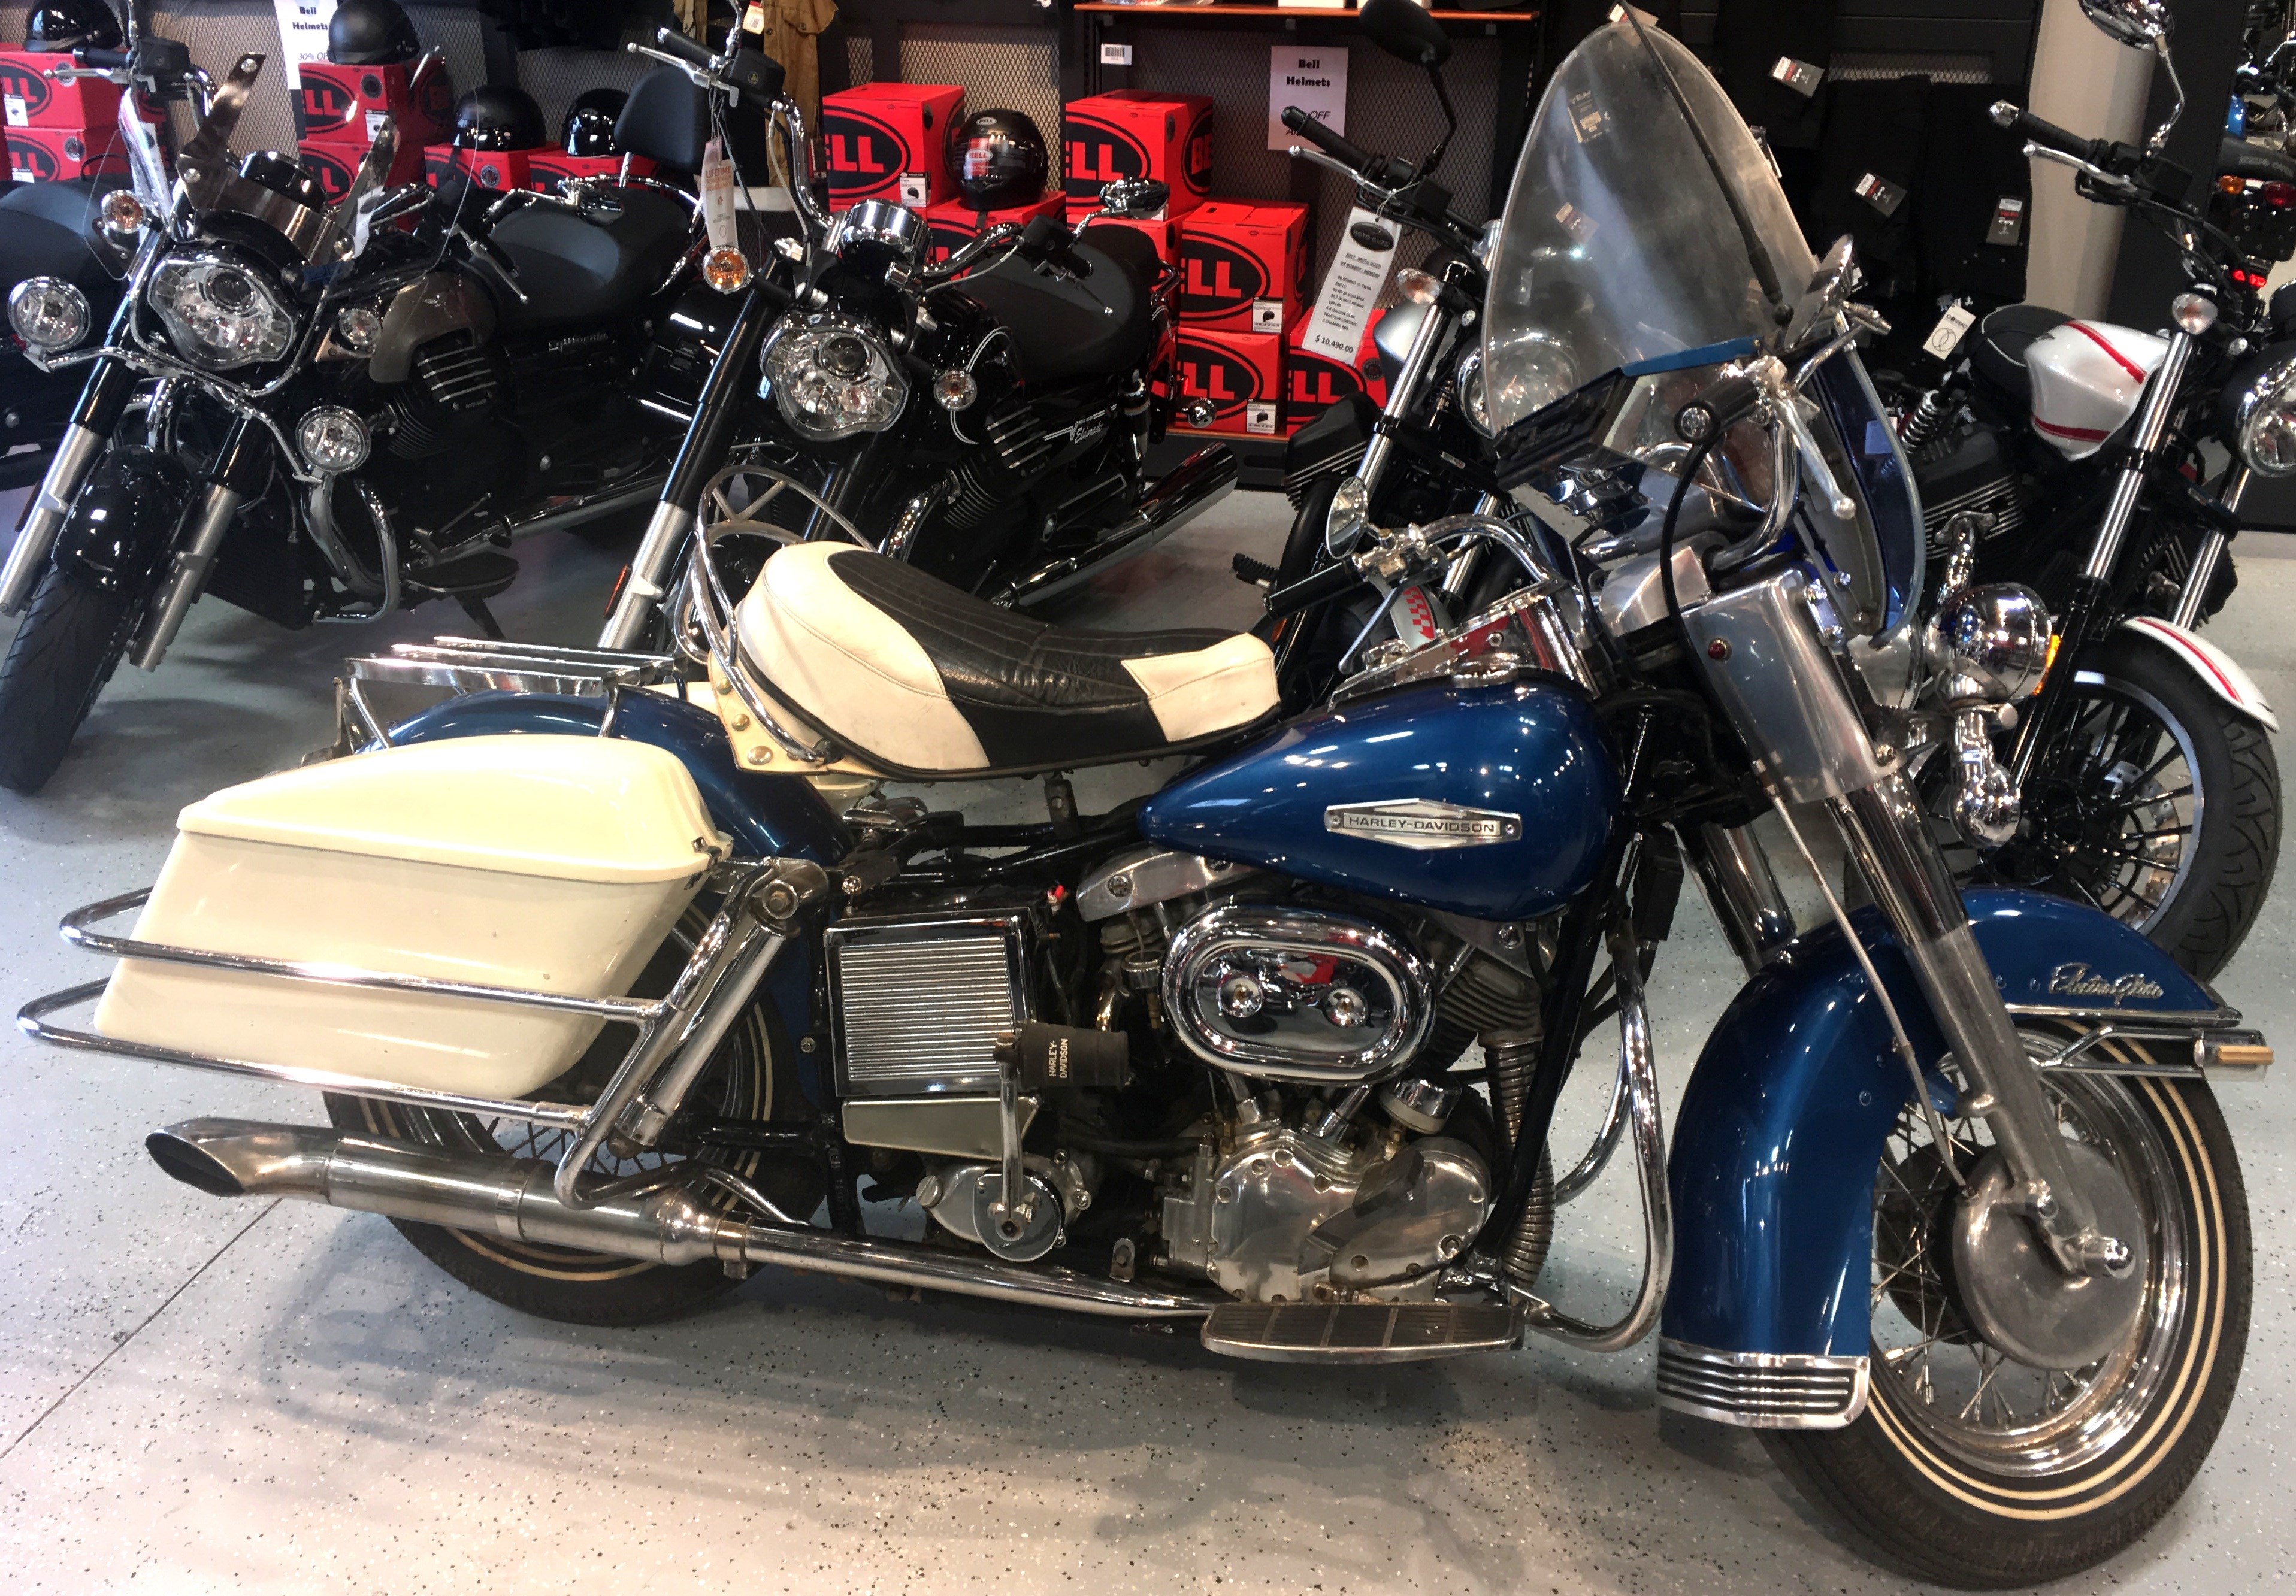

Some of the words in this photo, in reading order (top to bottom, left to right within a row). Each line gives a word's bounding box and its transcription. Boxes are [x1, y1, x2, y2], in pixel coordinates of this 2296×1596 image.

[299, 6, 317, 14] Bell
[1298, 59, 1320, 69] Bell
[1286, 75, 1330, 87] Helmets
[301, 89, 342, 116] LL
[825, 134, 885, 173] LL
[1066, 141, 1124, 181] LL
[1181, 258, 1242, 298] LL
[1315, 335, 1320, 346] $
[1321, 336, 1354, 353] 10,490.00
[1177, 361, 1235, 401] LL
[1288, 369, 1342, 404] LL
[1349, 816, 1495, 833] HARLEY-DAVIDSON
[1059, 1038, 1069, 1079] DAVIDSON
